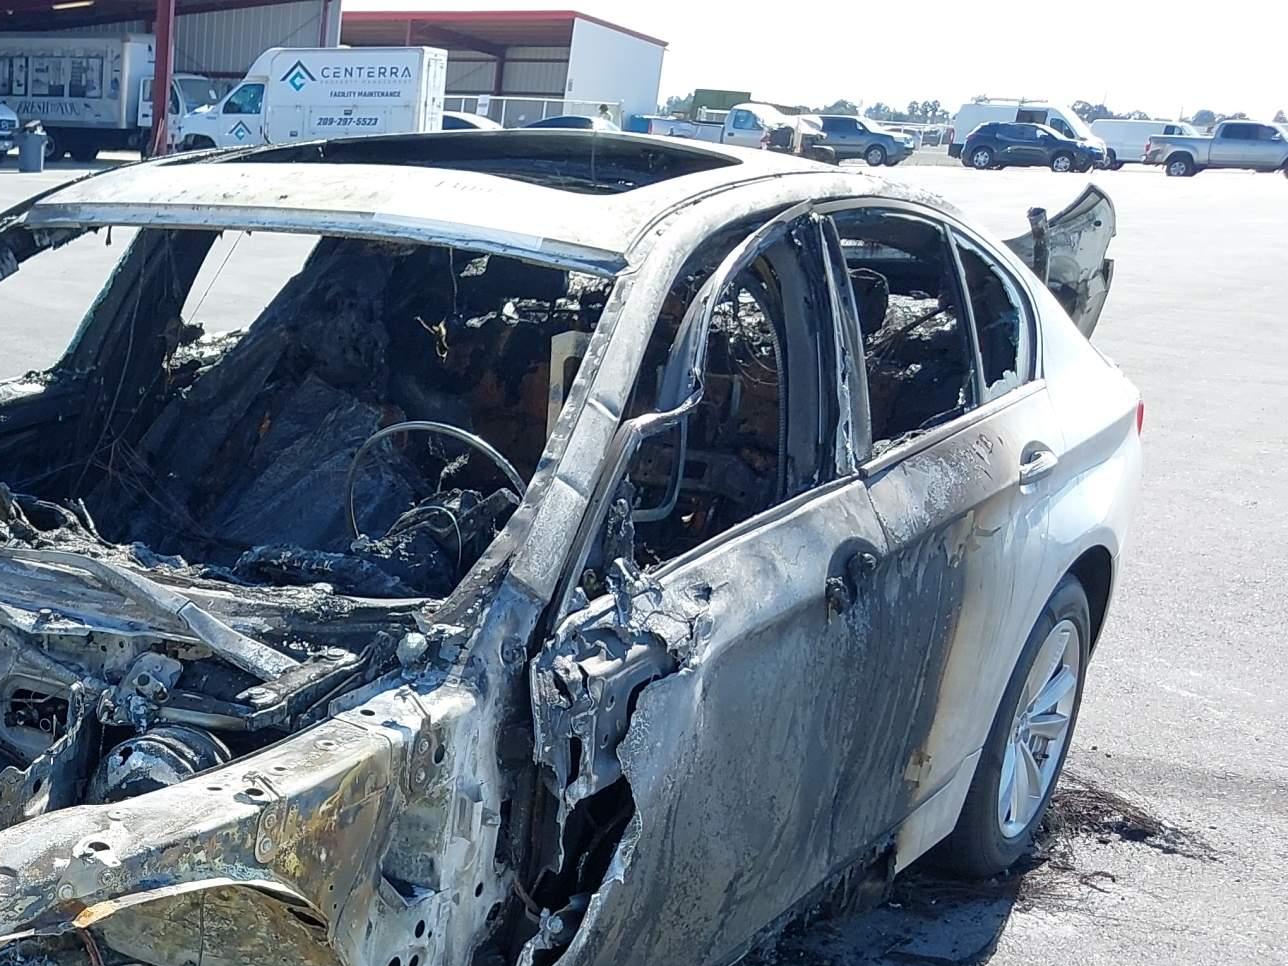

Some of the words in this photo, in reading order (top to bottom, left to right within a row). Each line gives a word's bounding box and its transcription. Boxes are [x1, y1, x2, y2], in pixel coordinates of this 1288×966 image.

[320, 66, 412, 78] CENTERRA
[329, 90, 357, 98] FACILITY
[357, 90, 401, 98] MAINTENANCE
[316, 117, 379, 126] 209-297-5523
